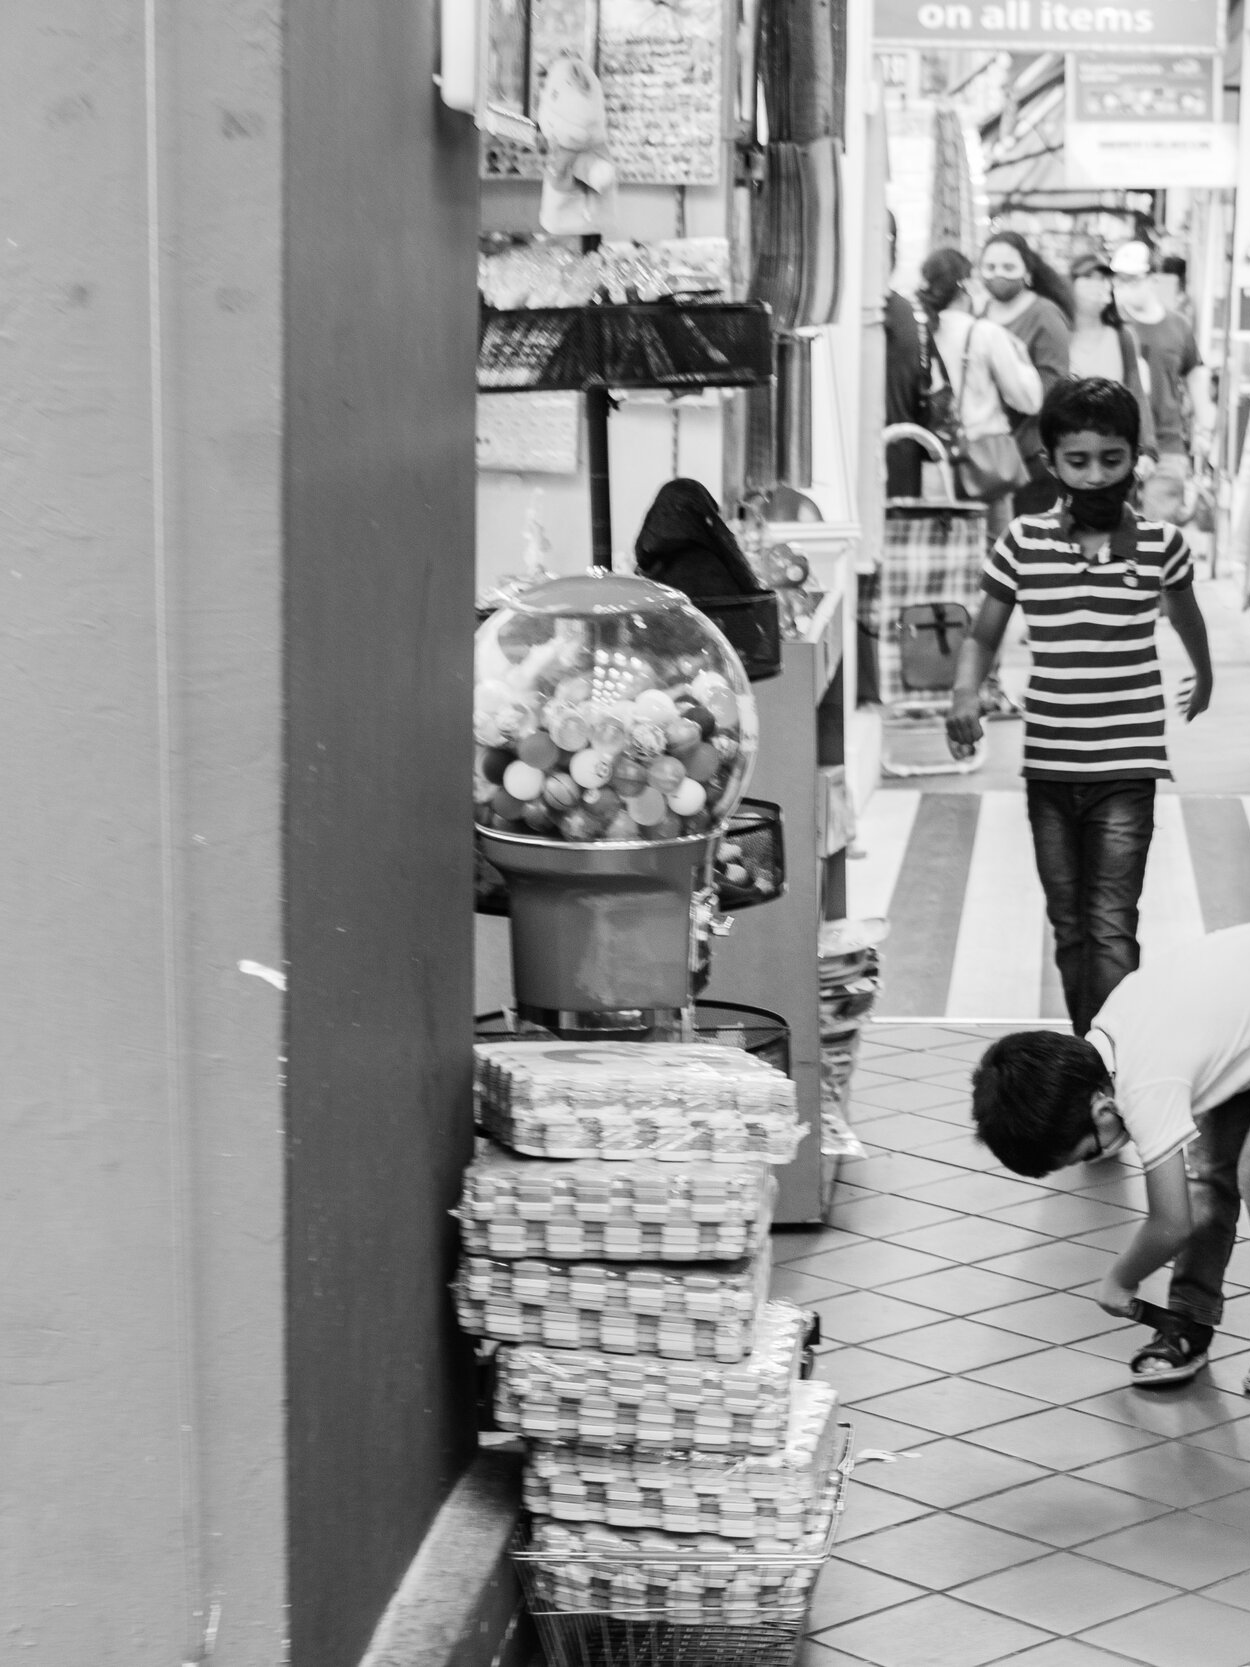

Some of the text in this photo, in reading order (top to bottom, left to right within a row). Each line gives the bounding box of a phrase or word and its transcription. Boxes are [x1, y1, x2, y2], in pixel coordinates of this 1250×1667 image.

[917, 0, 1155, 33] on all items
